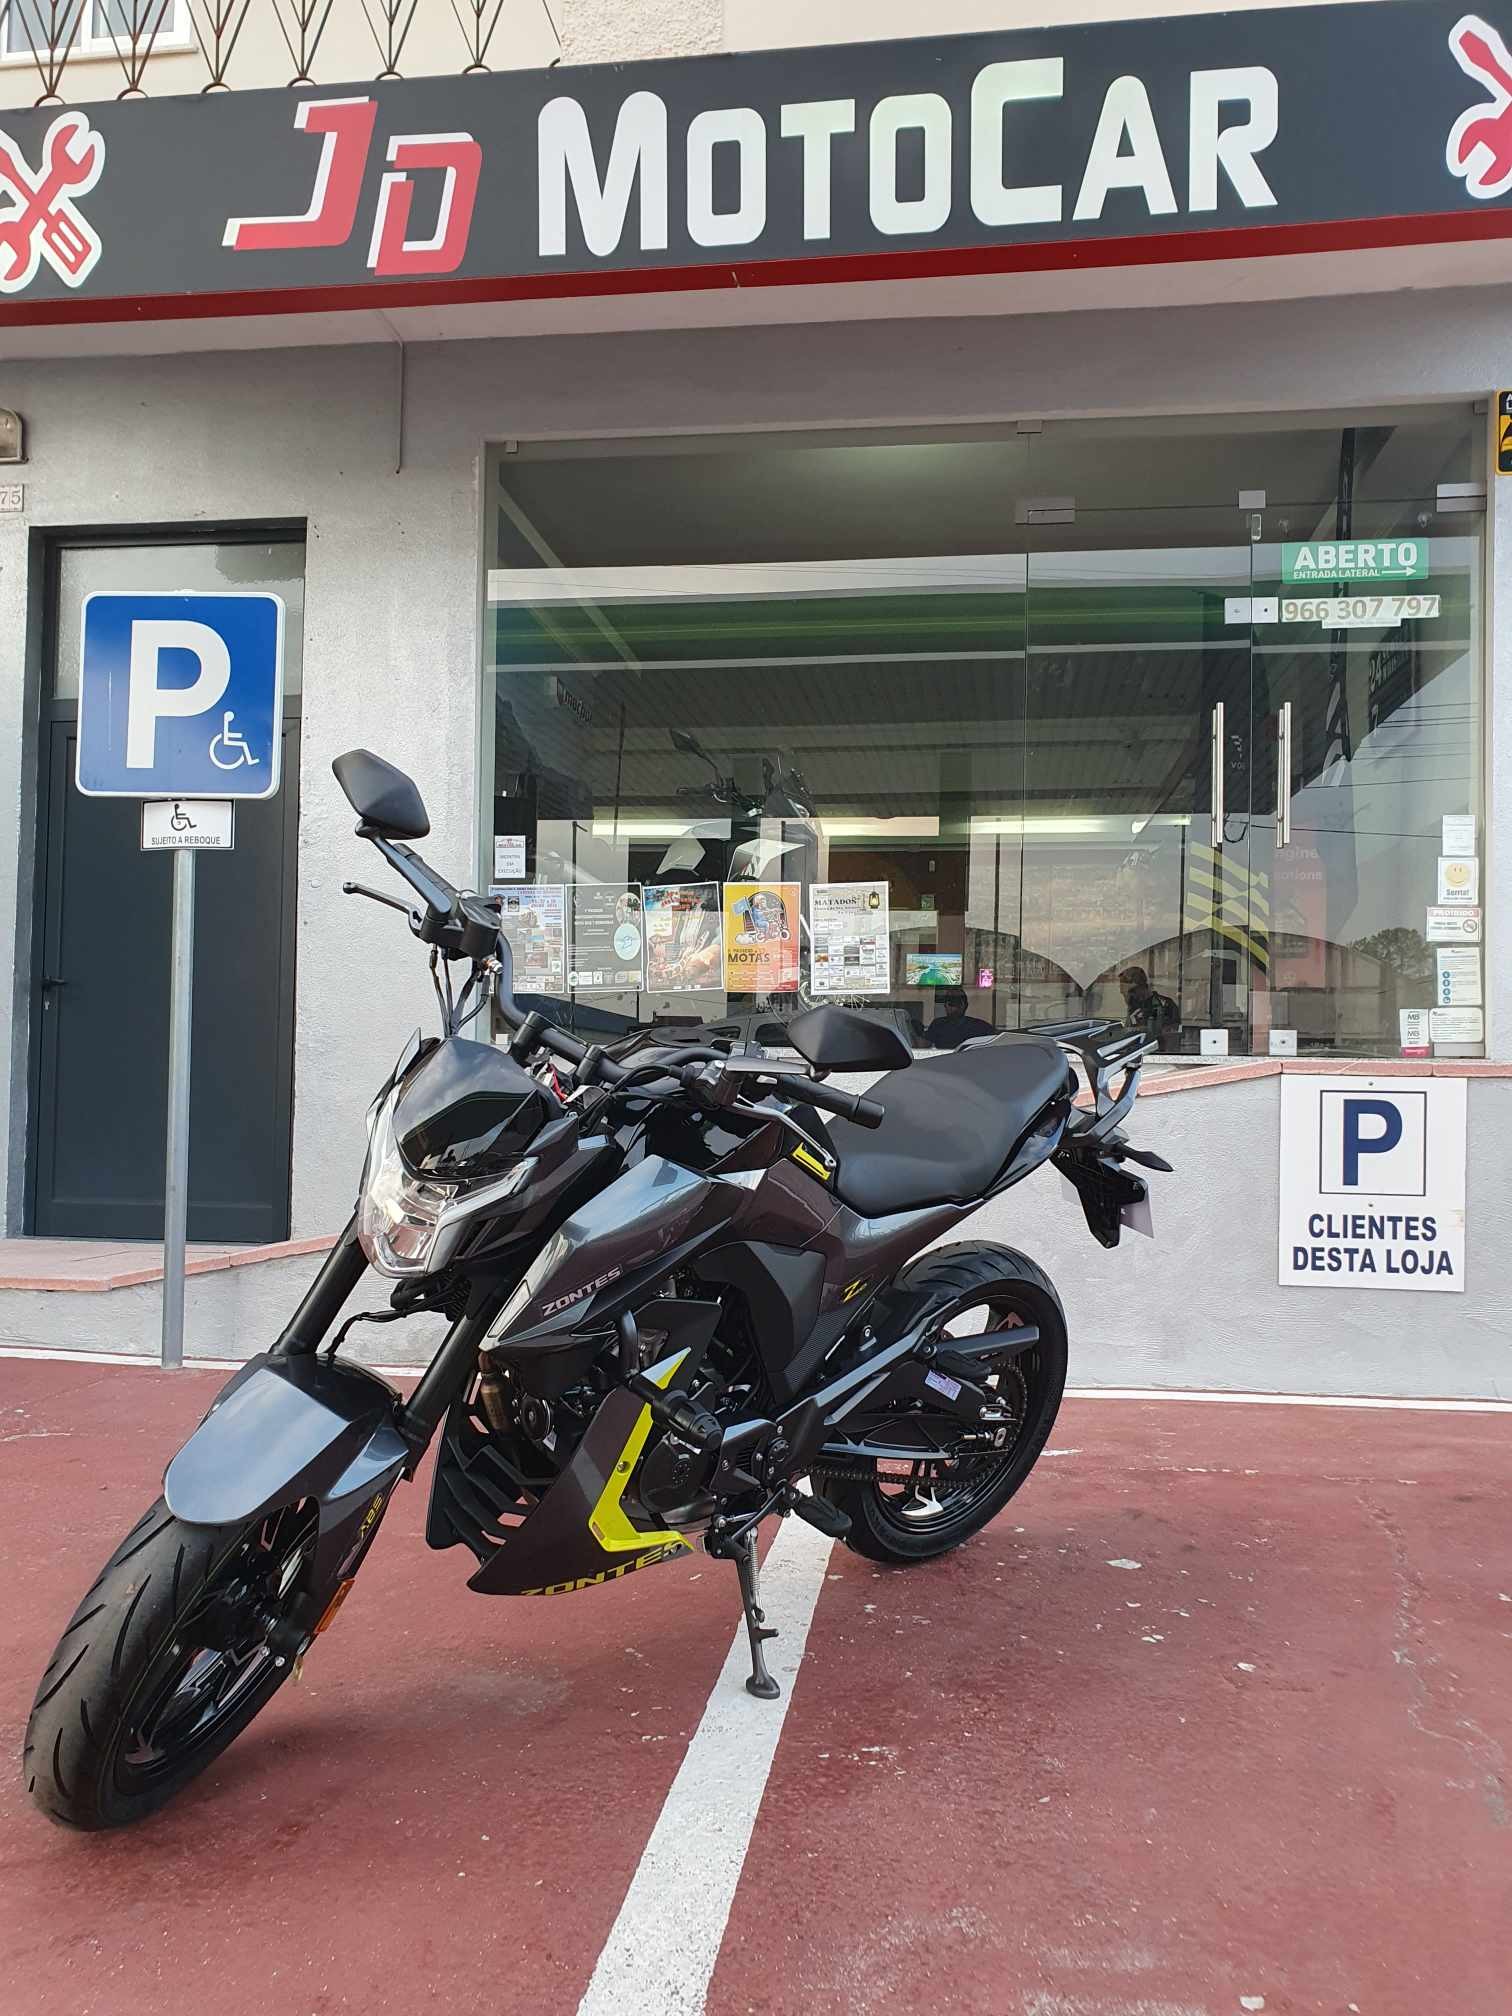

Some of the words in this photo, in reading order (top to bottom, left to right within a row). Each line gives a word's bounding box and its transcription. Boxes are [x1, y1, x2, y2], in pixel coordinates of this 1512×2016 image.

[1293, 542, 1418, 570] ABERTO
[1293, 569, 1337, 580] ENTRADA
[1339, 567, 1380, 578] LATERAL
[1284, 600, 1329, 621] 966
[1337, 598, 1383, 620] 307
[1391, 597, 1437, 617] 797
[126, 619, 231, 769] P
[151, 836, 177, 846] SUJEITO
[177, 836, 183, 845] A
[184, 835, 222, 845] REBOQUE
[727, 952, 771, 963] MOTAS
[1342, 1098, 1403, 1186] P
[1308, 1213, 1438, 1242] CLIENTES
[1292, 1245, 1377, 1273] DESTA
[1385, 1248, 1454, 1276] LOJA
[541, 1266, 621, 1317] ZONTES
